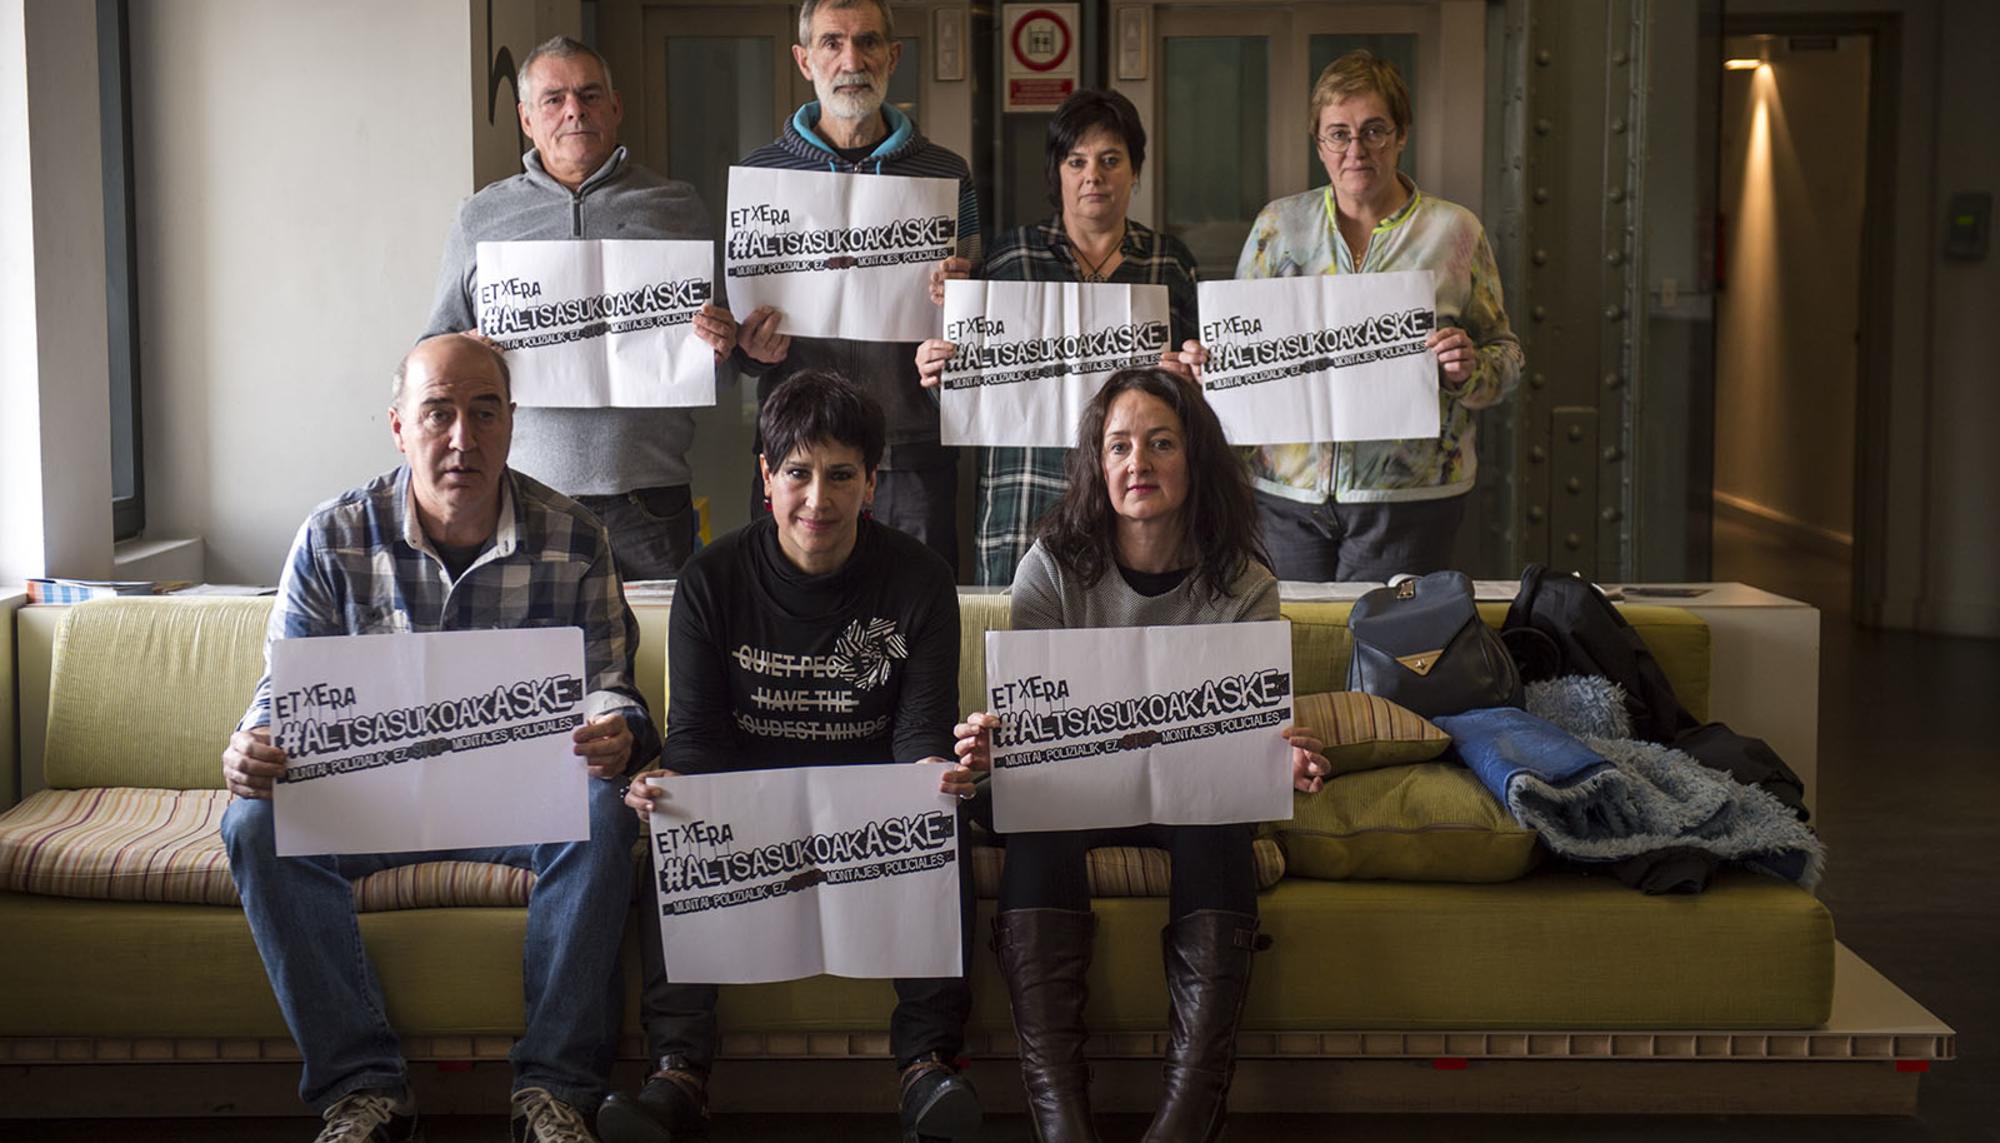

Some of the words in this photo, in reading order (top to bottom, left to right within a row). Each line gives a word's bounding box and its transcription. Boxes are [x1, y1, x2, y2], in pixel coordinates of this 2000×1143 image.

[731, 204, 790, 228] ETXERA
[813, 259, 825, 271] EZ
[857, 252, 900, 268] MONTAJES
[903, 247, 948, 264] POLICIALES
[482, 277, 542, 304] ETXERA
[611, 317, 653, 333] MONTAJES
[947, 315, 1005, 340] ETXERA
[1203, 315, 1263, 343] ETXERA
[1071, 359, 1114, 375] MONTAJES
[1334, 350, 1377, 369] MONTAJES
[736, 644, 795, 678] QUIET
[275, 682, 357, 719] ETXERA
[757, 686, 810, 712] HAVE
[815, 689, 854, 713] THE
[992, 675, 1070, 710] ETXERA
[393, 747, 409, 764] EZ
[451, 728, 510, 752] MONTAJES
[512, 717, 574, 741] POLICIALES
[1046, 741, 1101, 763] POLIZIALIK
[1105, 738, 1120, 754] EZ
[1160, 724, 1216, 745] MONTAJES
[1220, 711, 1280, 734] POLICIALES
[656, 820, 734, 855] ETXERA
[713, 884, 769, 909] POLIZIALIK
[772, 880, 788, 897] EZ
[826, 864, 881, 884] MONTAJES
[884, 853, 945, 877] POLICIALES
